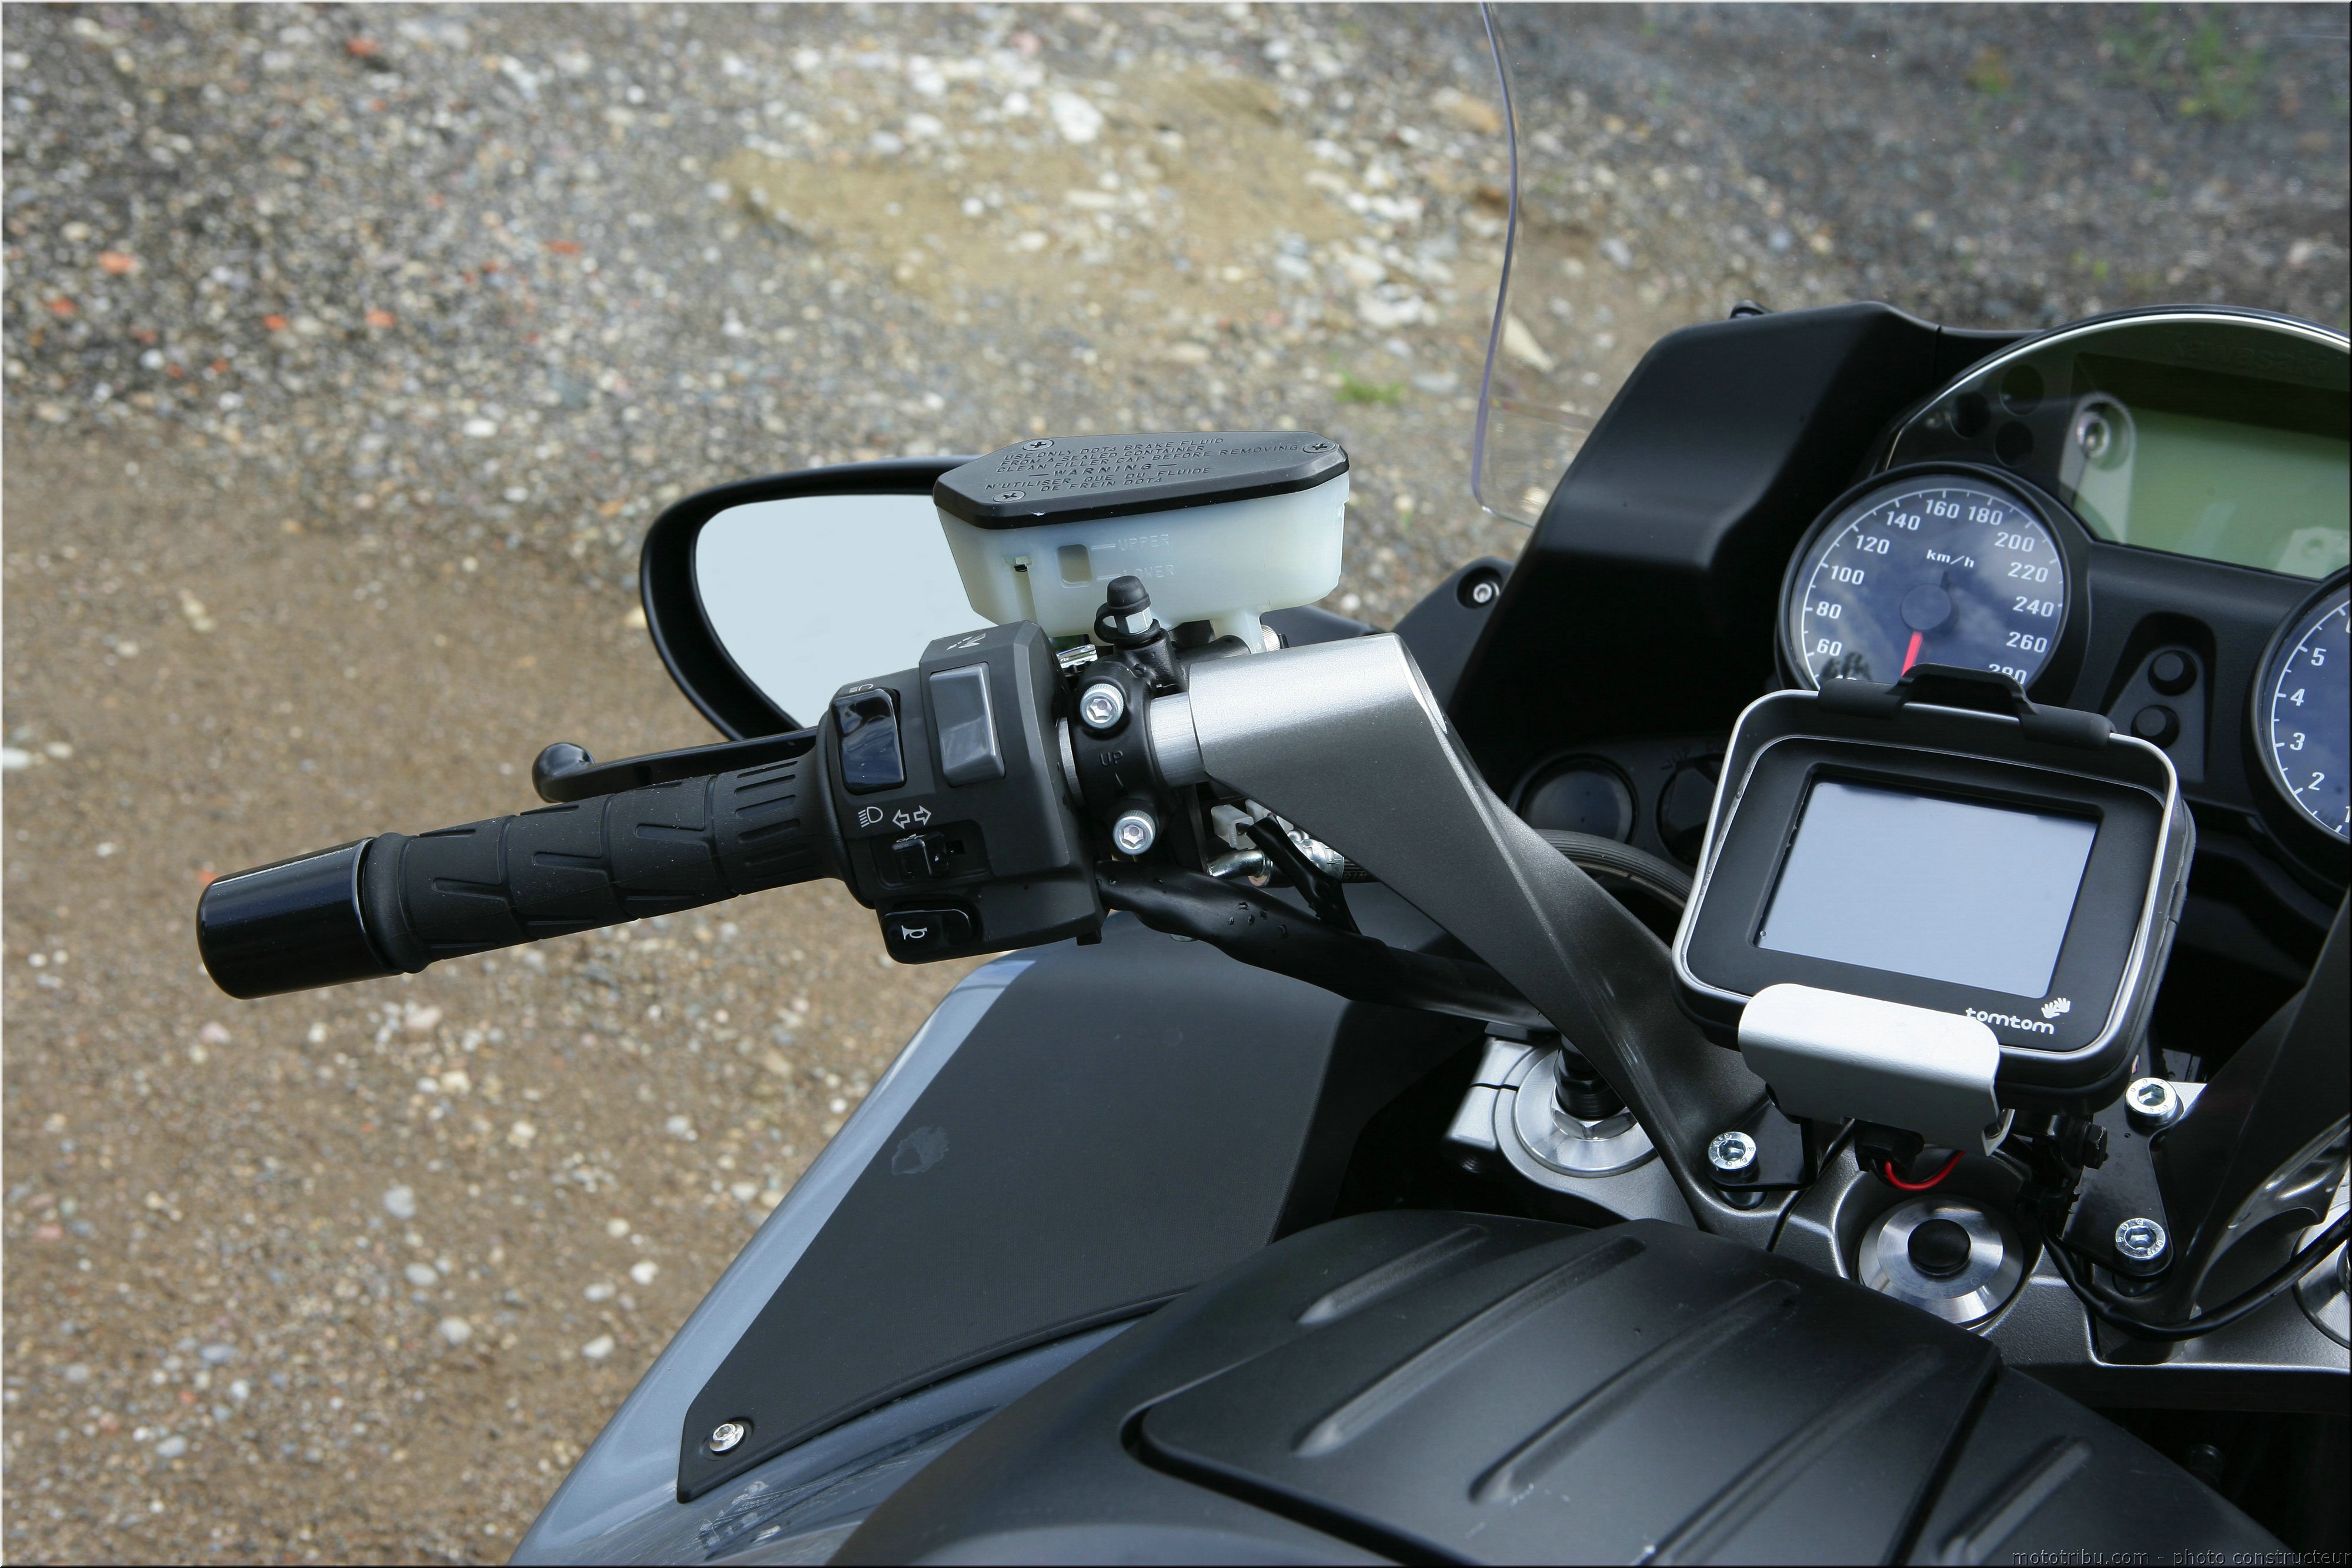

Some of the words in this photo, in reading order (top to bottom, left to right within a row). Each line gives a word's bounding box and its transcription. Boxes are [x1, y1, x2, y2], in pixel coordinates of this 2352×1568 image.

[1000, 459, 1040, 467] FROM
[1061, 452, 1118, 462] SEALED
[1124, 445, 1205, 457] CONTAINER
[1037, 449, 1075, 458] ONLY
[1123, 442, 1174, 451] BRAKE
[1179, 438, 1224, 447] FLUID
[996, 464, 1047, 473] CLEAN
[1053, 459, 1110, 469] FILLER
[1151, 452, 1212, 461] BEFORE
[1218, 444, 1298, 456] REMOVING
[984, 478, 1071, 490] N'UTILISER
[1083, 474, 1114, 483] QUE
[1156, 467, 1212, 477] FLUIDE
[1053, 463, 1152, 477] WARNING
[1068, 481, 1116, 490] FREIN
[1925, 499, 1960, 519] 160
[1968, 506, 2003, 526] 180
[1886, 511, 1922, 531] 140
[1118, 533, 1170, 551] UPPER
[1855, 534, 1891, 555] 120
[1994, 531, 2036, 553] 200
[1926, 549, 1975, 568] km/h
[1830, 565, 1865, 586] 100
[2007, 562, 2049, 583] 220
[1816, 601, 1842, 619] 80
[2012, 596, 2055, 617] 240
[1816, 638, 1843, 657] 60
[2006, 631, 2048, 653] 260
[2311, 647, 2327, 666] 5
[2290, 688, 2306, 706] 4
[2290, 732, 2306, 751] 3
[1098, 750, 1124, 767] UP
[2308, 772, 2325, 791] 2
[1965, 1007, 2055, 1035] tomtom
